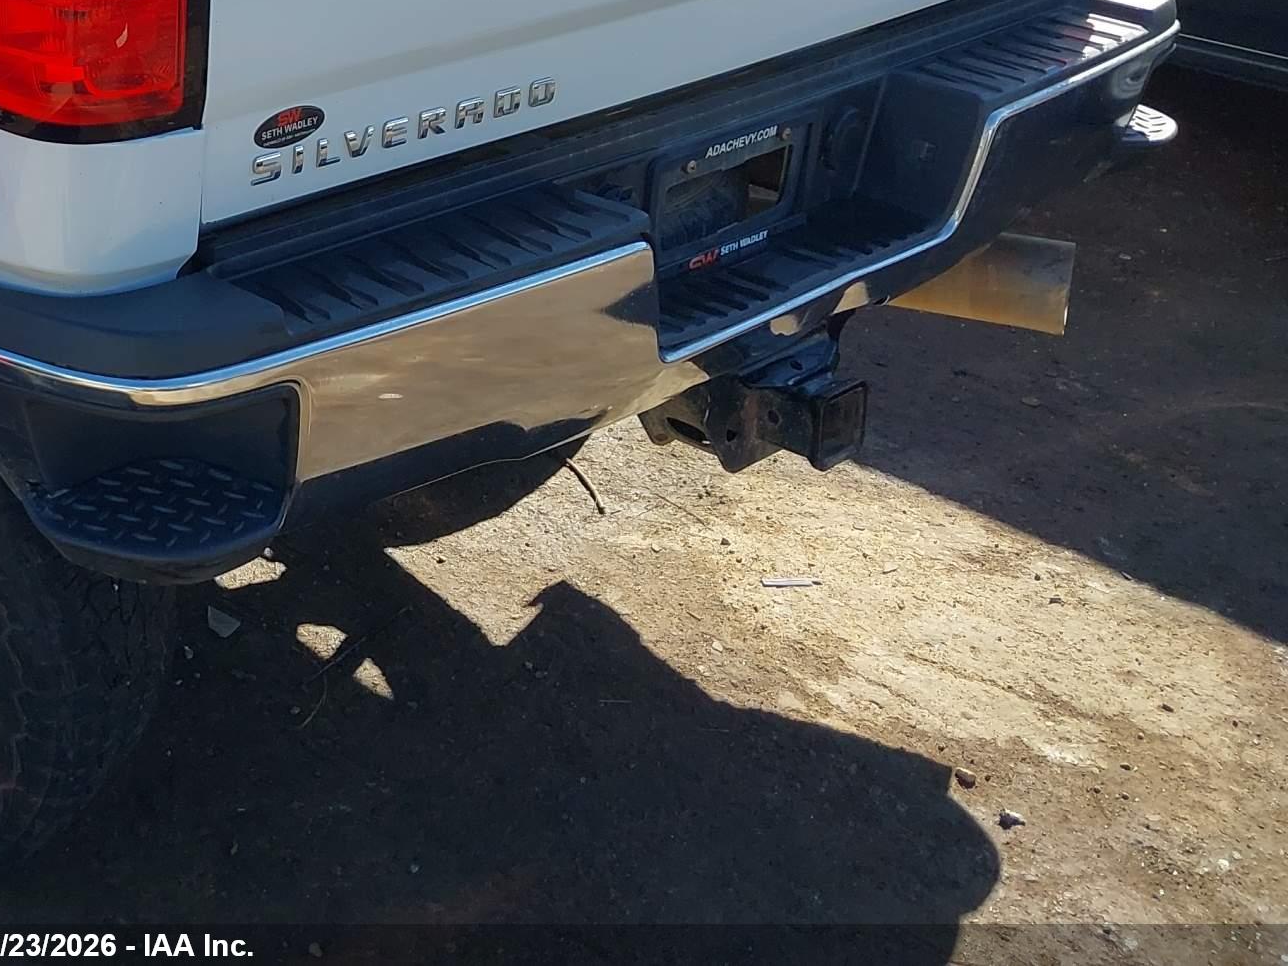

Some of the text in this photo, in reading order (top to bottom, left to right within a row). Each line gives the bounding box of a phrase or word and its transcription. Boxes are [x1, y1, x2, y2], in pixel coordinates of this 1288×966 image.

[250, 76, 557, 186] SILVERADO
[261, 125, 283, 141] SETH
[284, 116, 318, 134] WADLEY
[705, 125, 778, 159] ADACHEVY.COM
[720, 241, 739, 256] SETH
[739, 230, 768, 248] WADLEY
